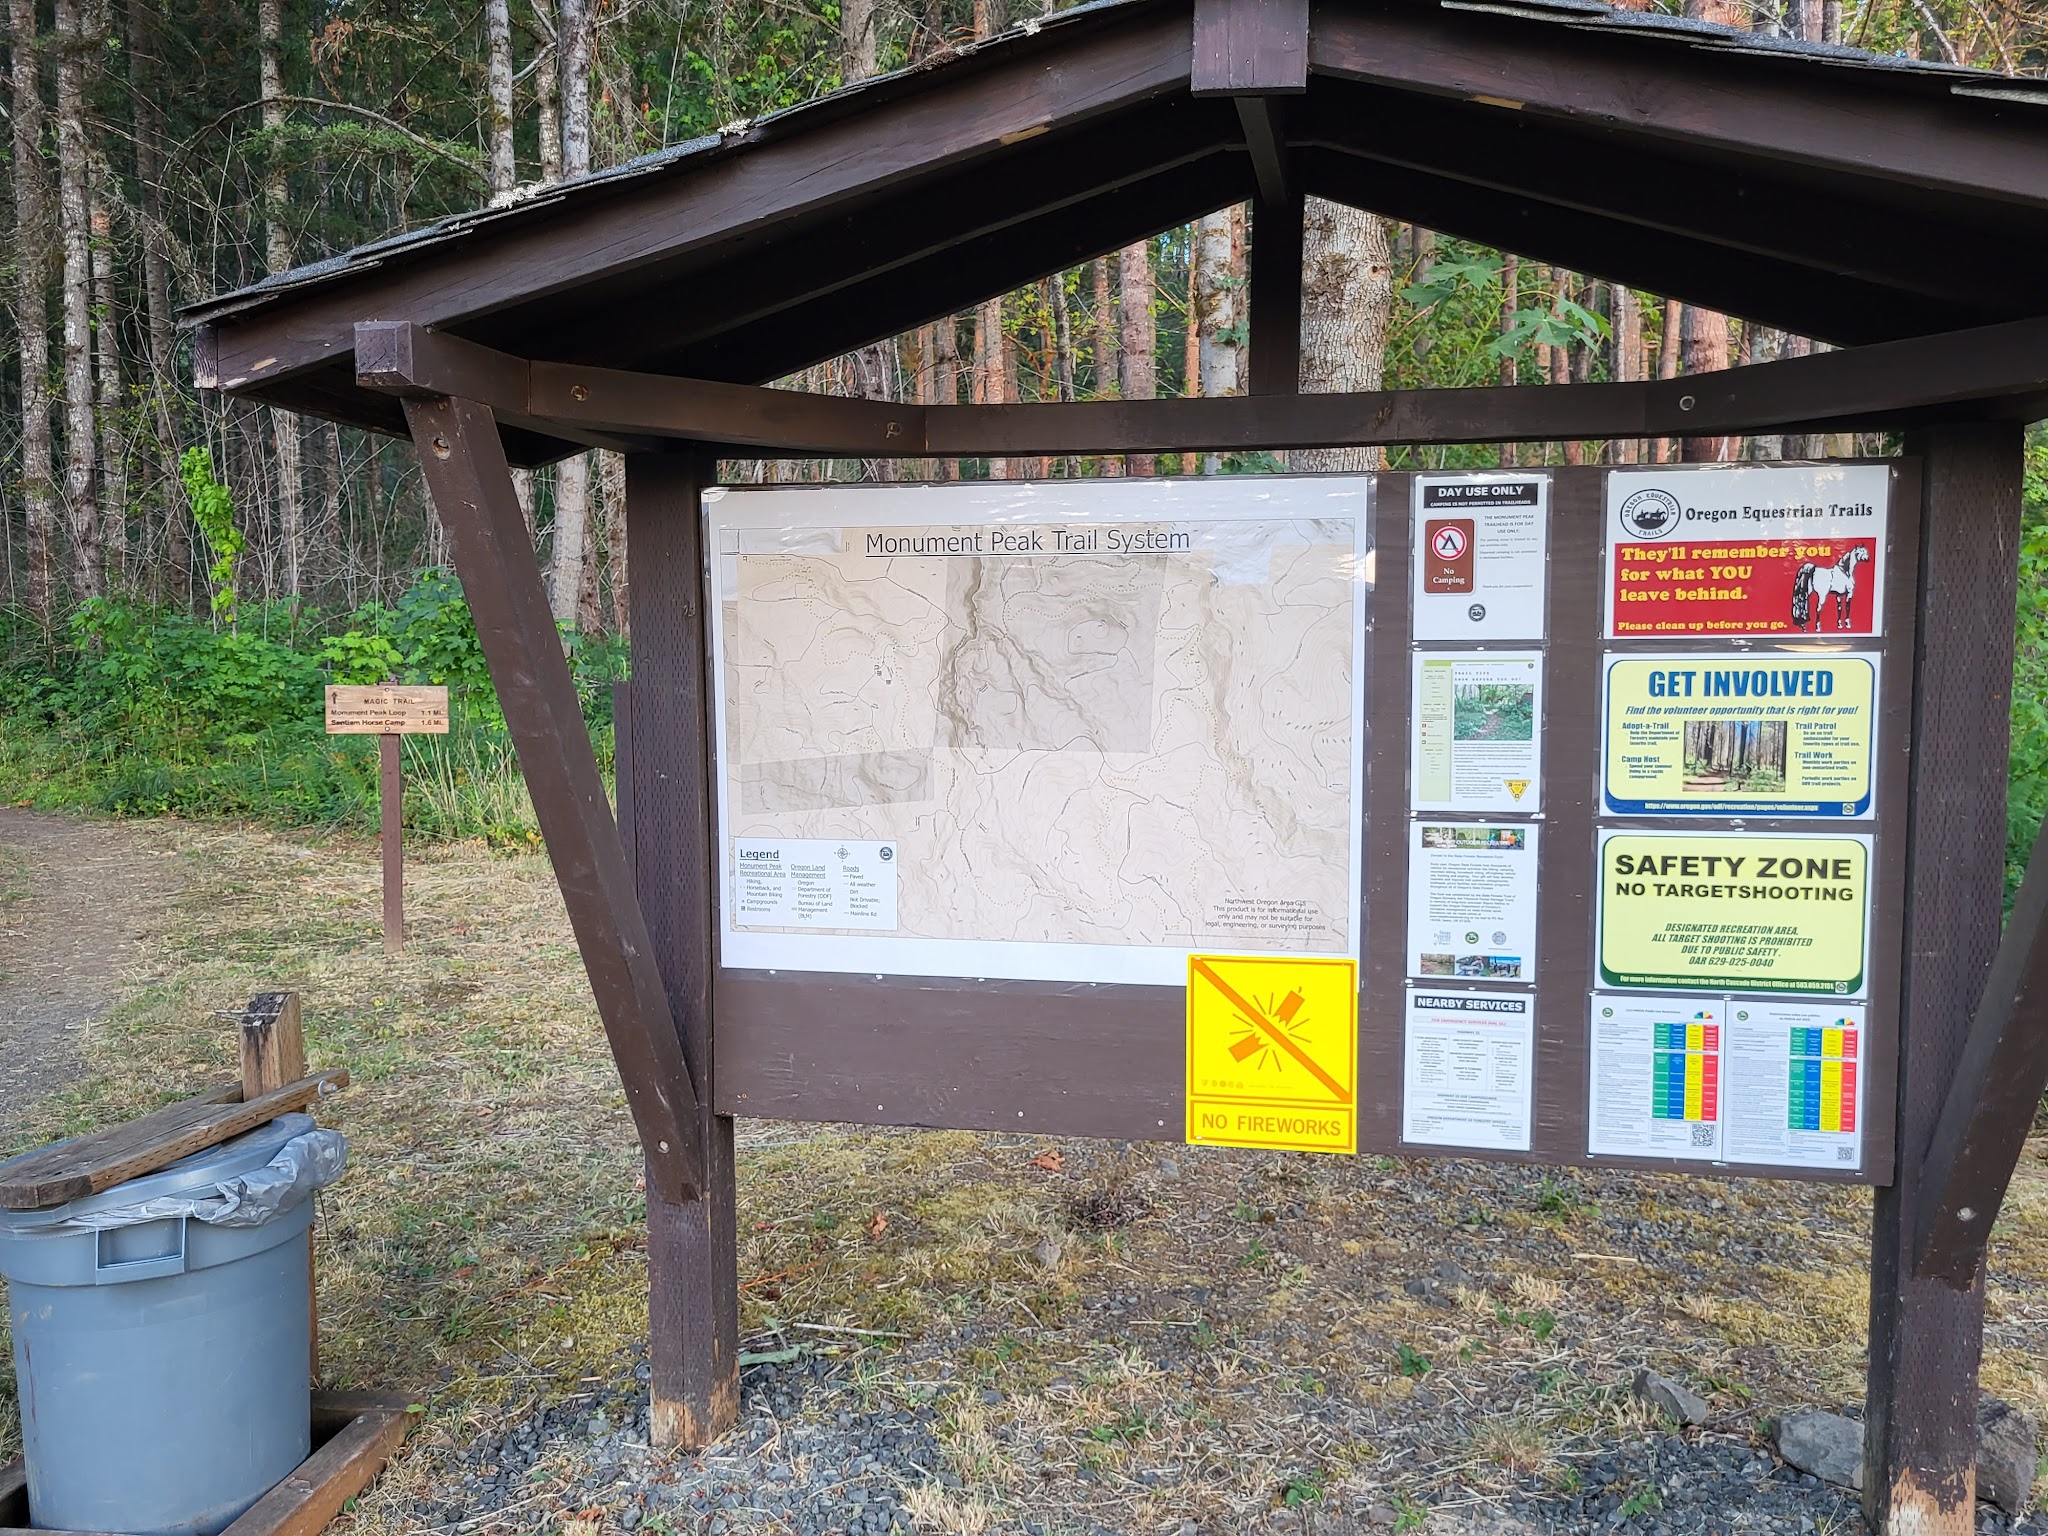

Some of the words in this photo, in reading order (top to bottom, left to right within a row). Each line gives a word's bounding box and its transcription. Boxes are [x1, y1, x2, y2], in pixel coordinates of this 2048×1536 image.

[1438, 488, 1462, 497] DAY
[1466, 487, 1488, 496] USE
[1492, 486, 1524, 496] ONLY
[1686, 507, 1737, 522] Oregon
[1742, 506, 1823, 522] Equestrian
[1829, 504, 1872, 518] Trails
[866, 532, 983, 553] Monument
[991, 531, 1044, 551] Peak
[1052, 529, 1097, 551] Trail
[1107, 529, 1190, 554] System
[1621, 547, 1686, 562] They'll
[1692, 545, 1789, 559] remember
[1795, 546, 1831, 560] you
[1621, 568, 1650, 581] for
[1656, 567, 1704, 580] what
[1710, 566, 1752, 580] YOU
[1432, 576, 1465, 585] Camping
[1620, 589, 1670, 602] leave
[1676, 587, 1748, 601] behind.
[1618, 622, 1652, 631] Please
[1656, 622, 1686, 630] clean
[1688, 623, 1703, 631] up
[1706, 621, 1744, 630] before
[1747, 622, 1767, 631] you
[1771, 622, 1787, 631] go.
[1649, 671, 1696, 697] GET
[1704, 670, 1833, 697] INVOLVED
[1626, 706, 1646, 714] Find
[1646, 706, 1662, 714] the
[1664, 706, 1708, 714] volunteer
[1709, 706, 1765, 716] opportunity
[1766, 706, 1785, 714] that
[1786, 706, 1796, 714] is
[1797, 706, 1822, 715] right
[1822, 706, 1836, 714] for
[1836, 706, 1859, 715] you!
[740, 849, 779, 860] Legend
[1615, 855, 1746, 878] SAFETY
[1756, 857, 1851, 879] ZONE
[1616, 883, 1646, 896] NO
[1665, 923, 1719, 933] DESIGNATED
[1720, 925, 1774, 934] RECREATION
[1774, 926, 1799, 935] AREA.
[1652, 934, 1666, 942] ALL
[1668, 934, 1702, 943] TARGET
[1702, 935, 1746, 944] SHOOTING
[1759, 937, 1813, 946] PROHIBITED
[1681, 945, 1699, 954] DUE
[1701, 946, 1711, 954] TO
[1713, 946, 1744, 955] PUBLIC
[1689, 956, 1707, 965] OAR
[1708, 957, 1774, 967] 629-025-0040
[1418, 998, 1463, 1008] NEARBY
[1466, 1000, 1522, 1011] SERVICES
[1202, 1113, 1227, 1129] NO
[1238, 1115, 1341, 1136] FIREWORKS
